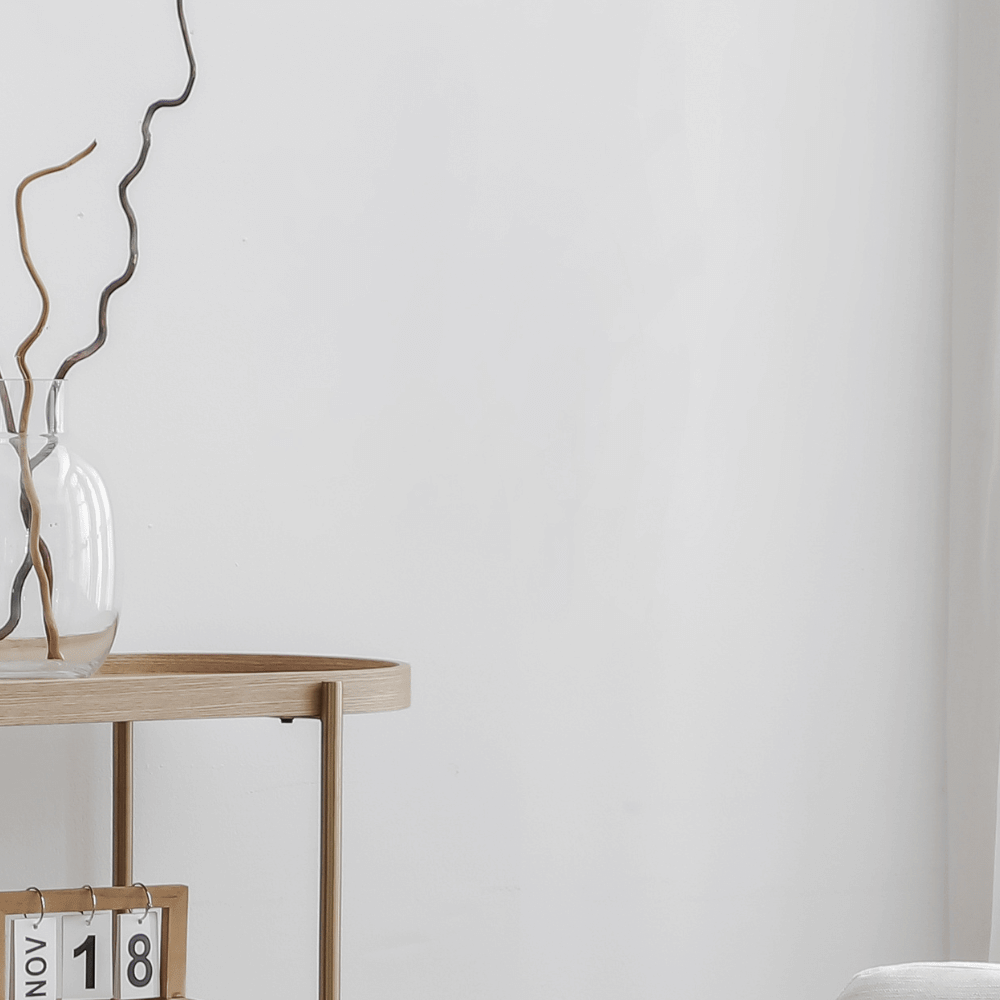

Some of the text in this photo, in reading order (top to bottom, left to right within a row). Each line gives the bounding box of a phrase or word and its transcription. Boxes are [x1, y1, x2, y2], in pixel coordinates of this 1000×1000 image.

[25, 933, 153, 998] NOV 1 8
